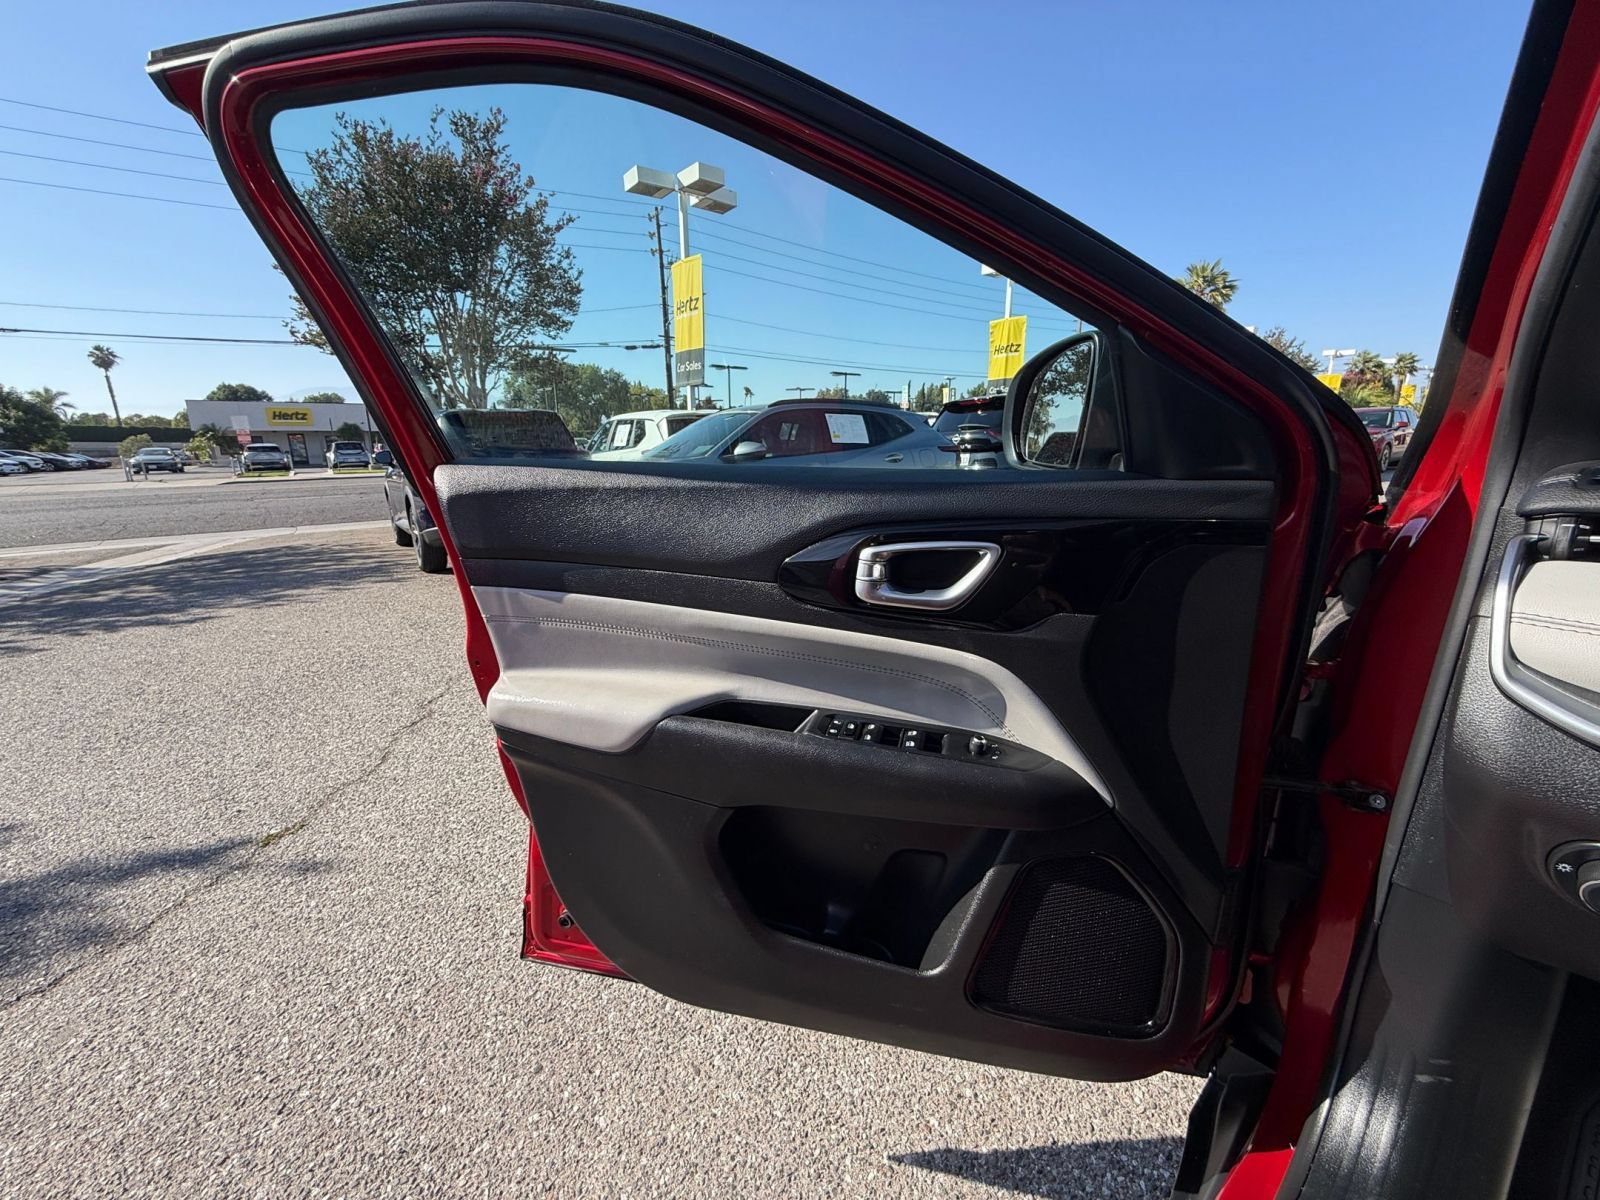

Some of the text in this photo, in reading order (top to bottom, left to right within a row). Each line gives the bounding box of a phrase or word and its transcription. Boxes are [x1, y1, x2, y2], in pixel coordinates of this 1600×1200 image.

[676, 296, 700, 316] Hertz
[993, 343, 1022, 355] Hertz
[677, 361, 702, 373] Car Sales
[272, 411, 308, 420] Hertz
